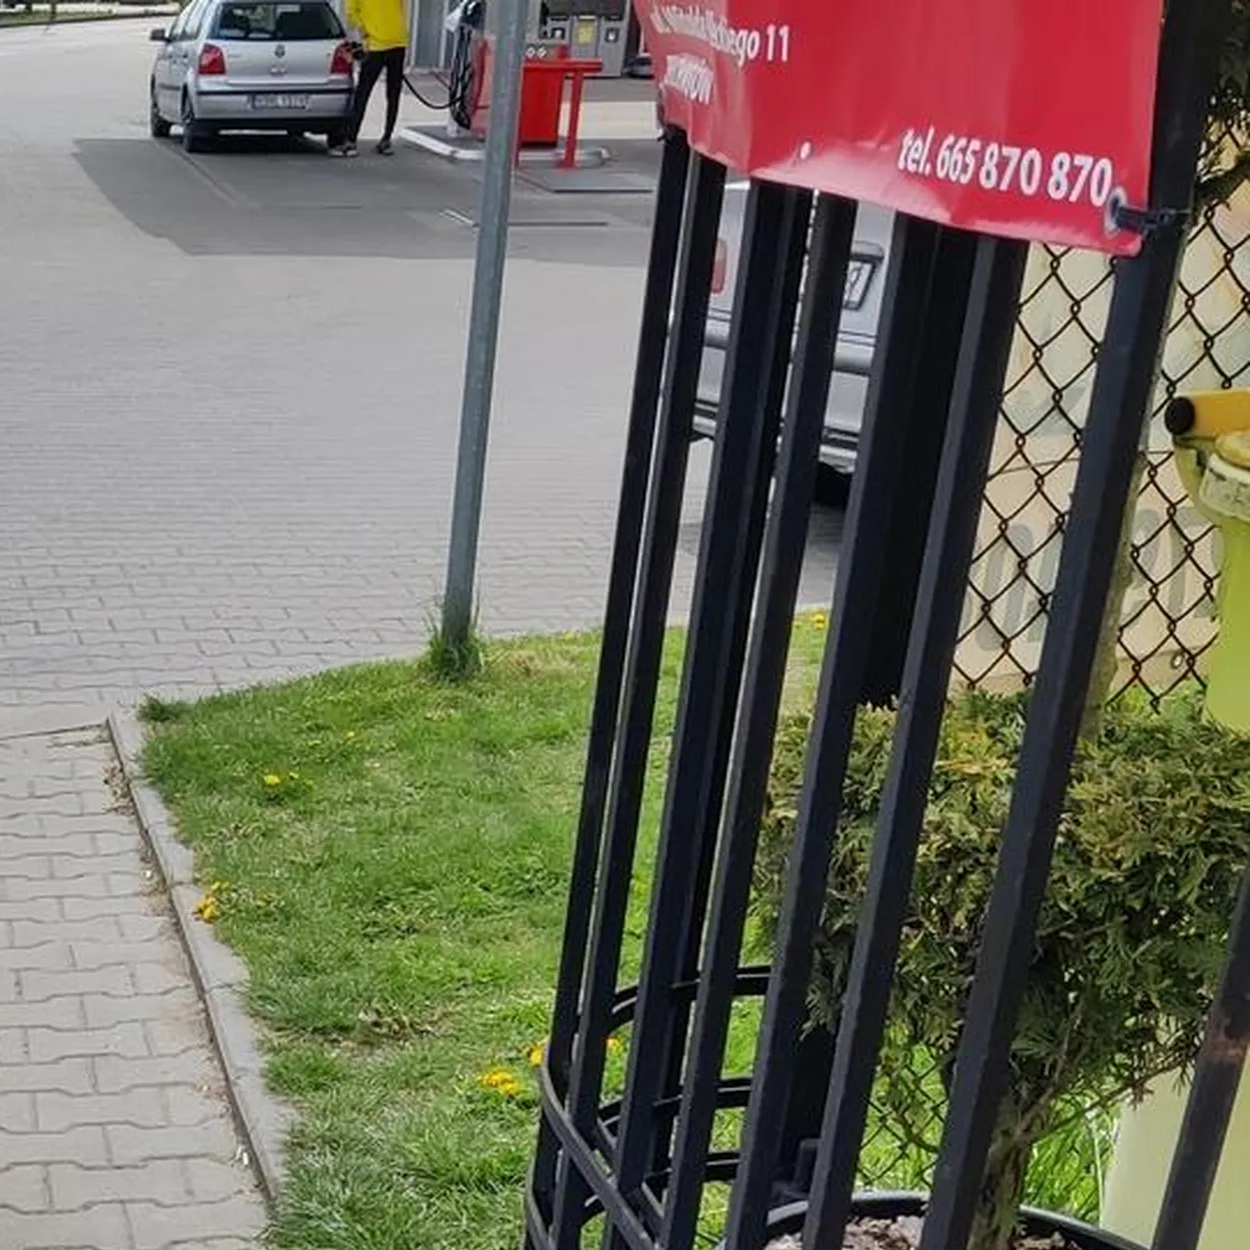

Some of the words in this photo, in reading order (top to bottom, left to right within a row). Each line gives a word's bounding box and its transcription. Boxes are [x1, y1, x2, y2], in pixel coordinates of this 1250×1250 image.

[766, 24, 790, 62] 11
[897, 125, 932, 177] tel.
[935, 133, 981, 185] 665
[978, 144, 1043, 196] 870
[1048, 152, 1112, 207] 870
